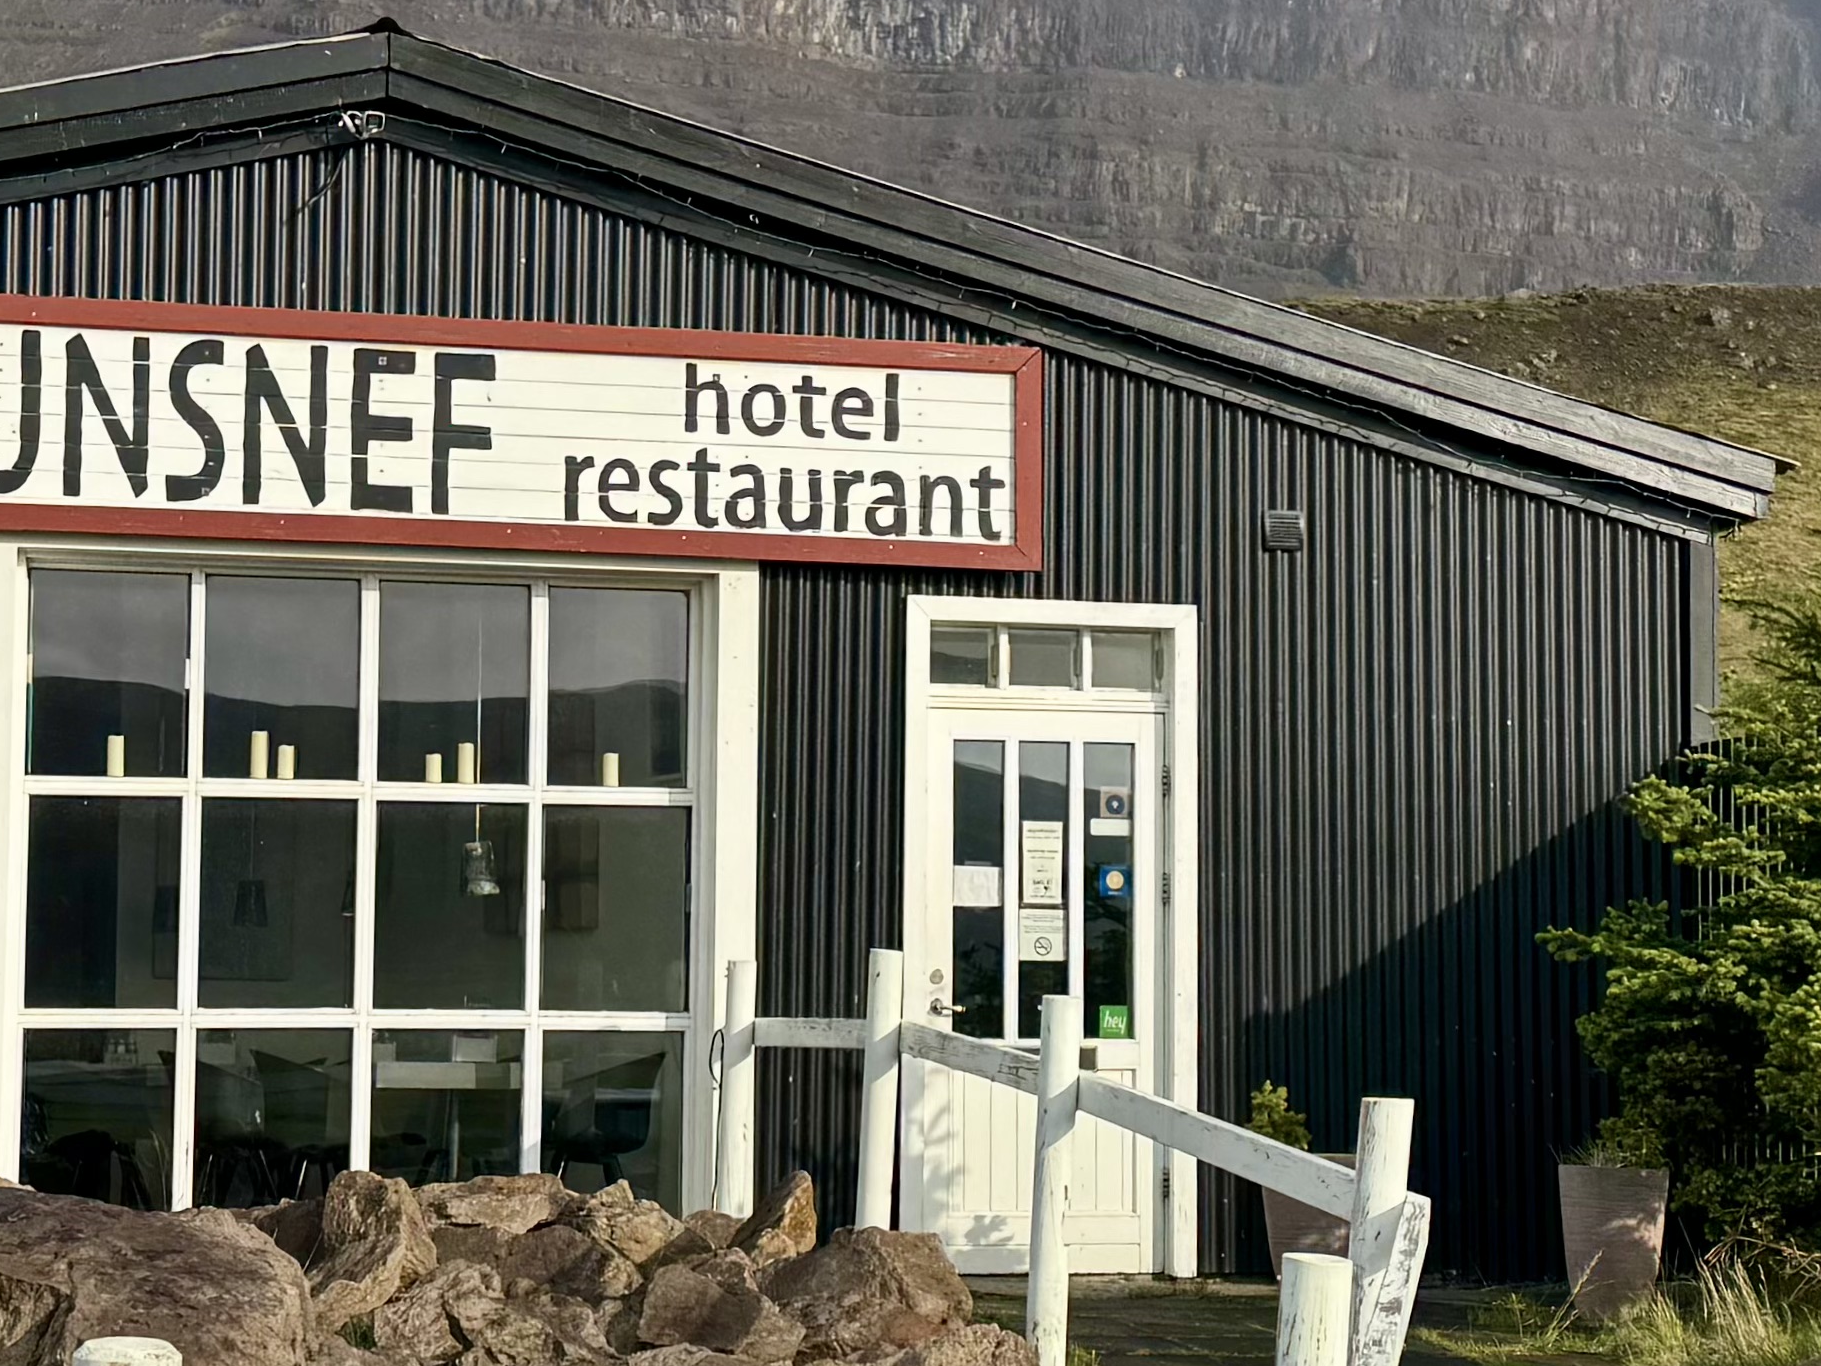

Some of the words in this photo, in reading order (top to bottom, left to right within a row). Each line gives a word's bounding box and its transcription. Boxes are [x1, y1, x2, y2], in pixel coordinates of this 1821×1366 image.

[683, 362, 901, 442] hotel
[563, 447, 1007, 542] restaurant
[1103, 1010, 1127, 1035] hey
